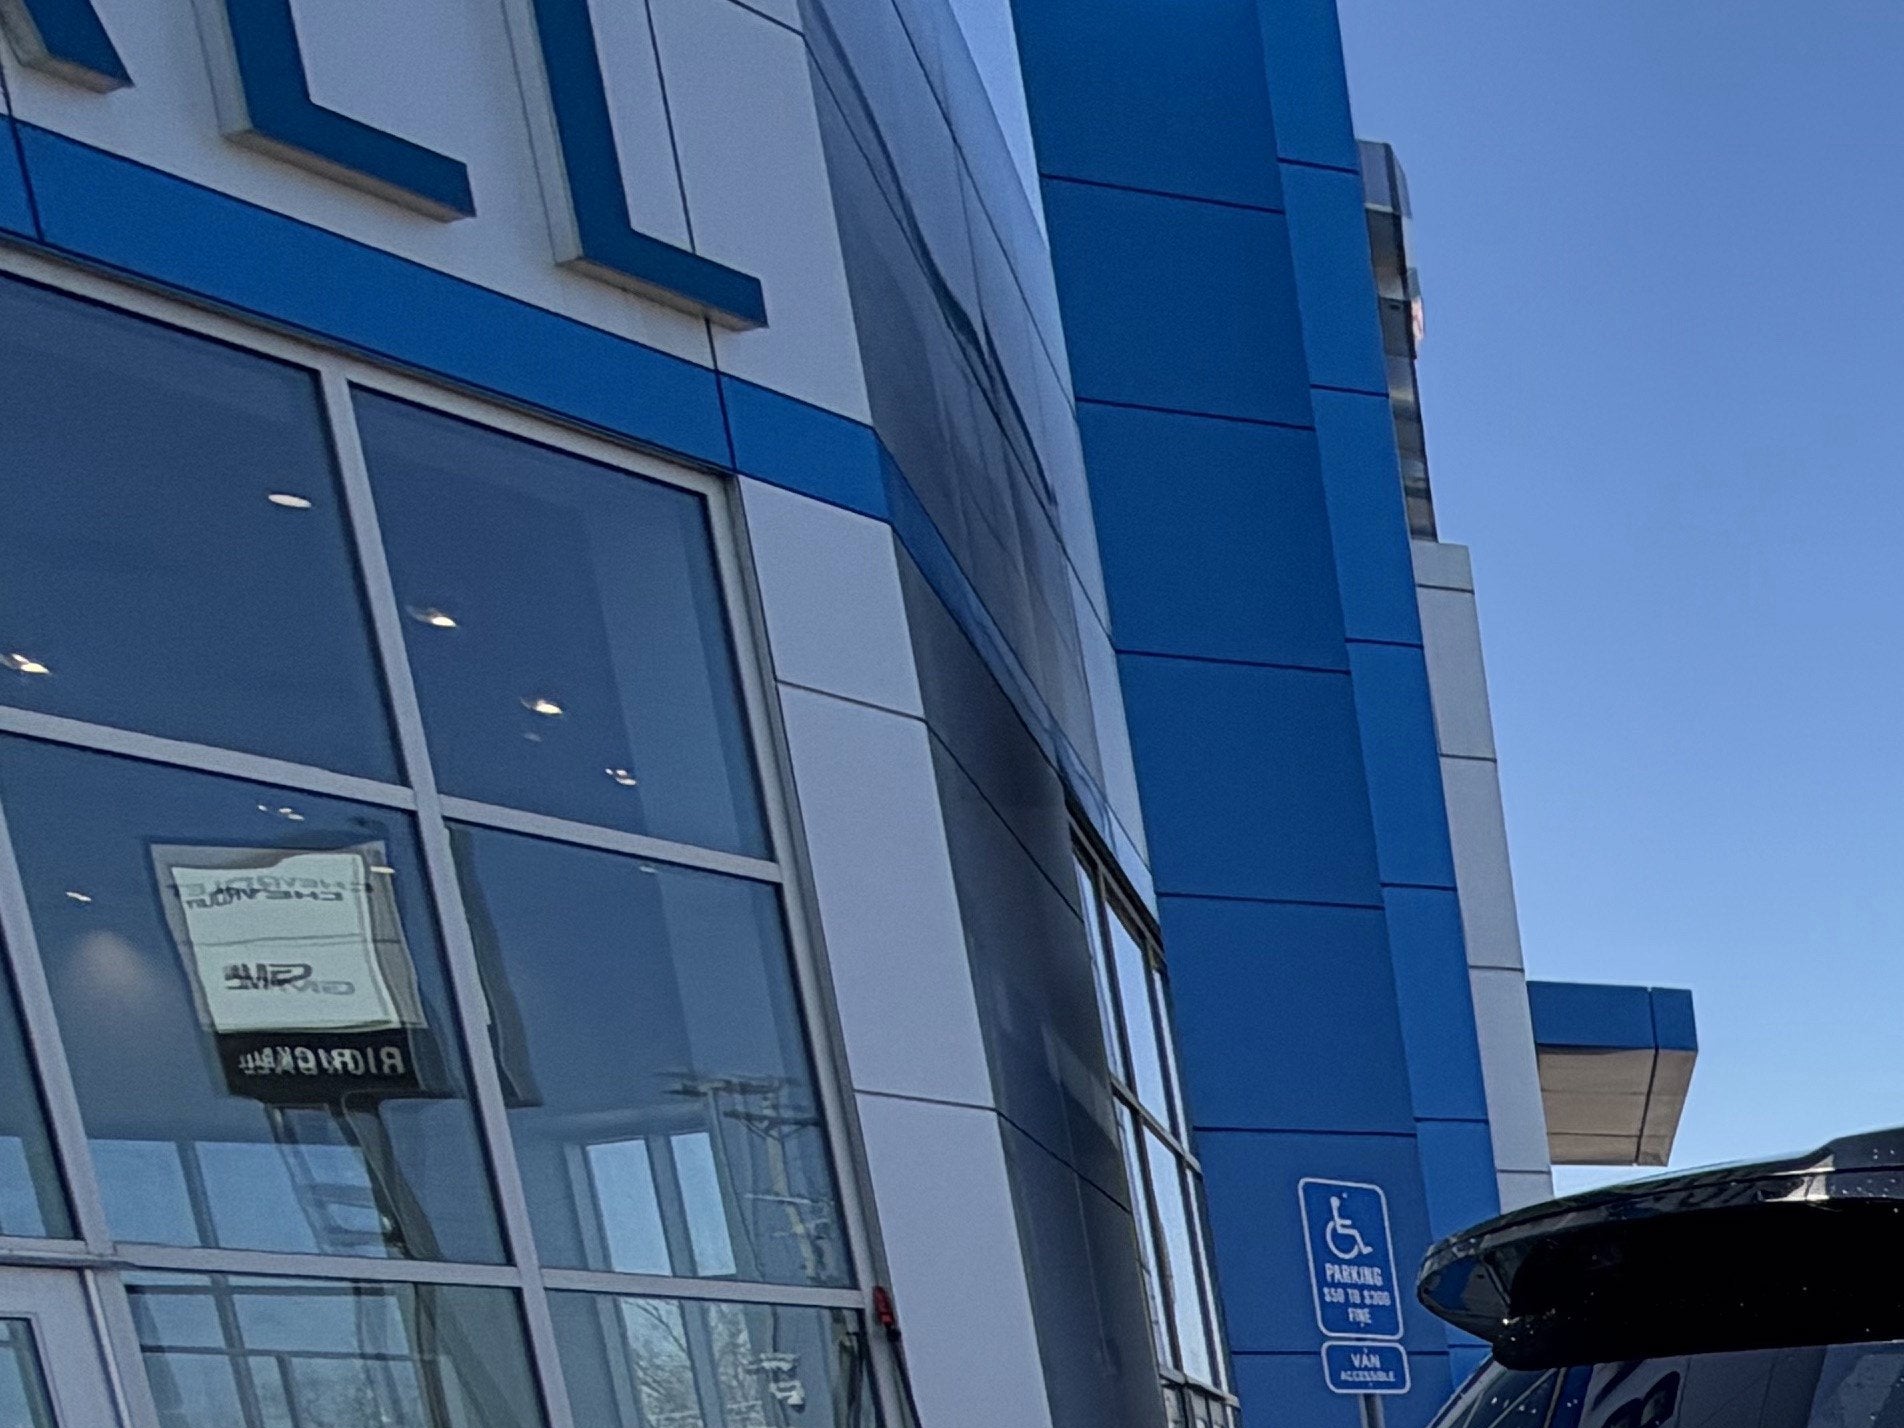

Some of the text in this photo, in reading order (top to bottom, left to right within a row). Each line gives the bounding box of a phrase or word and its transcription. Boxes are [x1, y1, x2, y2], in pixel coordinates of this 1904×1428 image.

[1325, 1263, 1383, 1286] PARKING
[1347, 1288, 1361, 1304] TO
[1347, 1307, 1372, 1323] FINE
[1351, 1353, 1380, 1369] VAN
[1340, 1370, 1396, 1382] ACCESSIBLE
